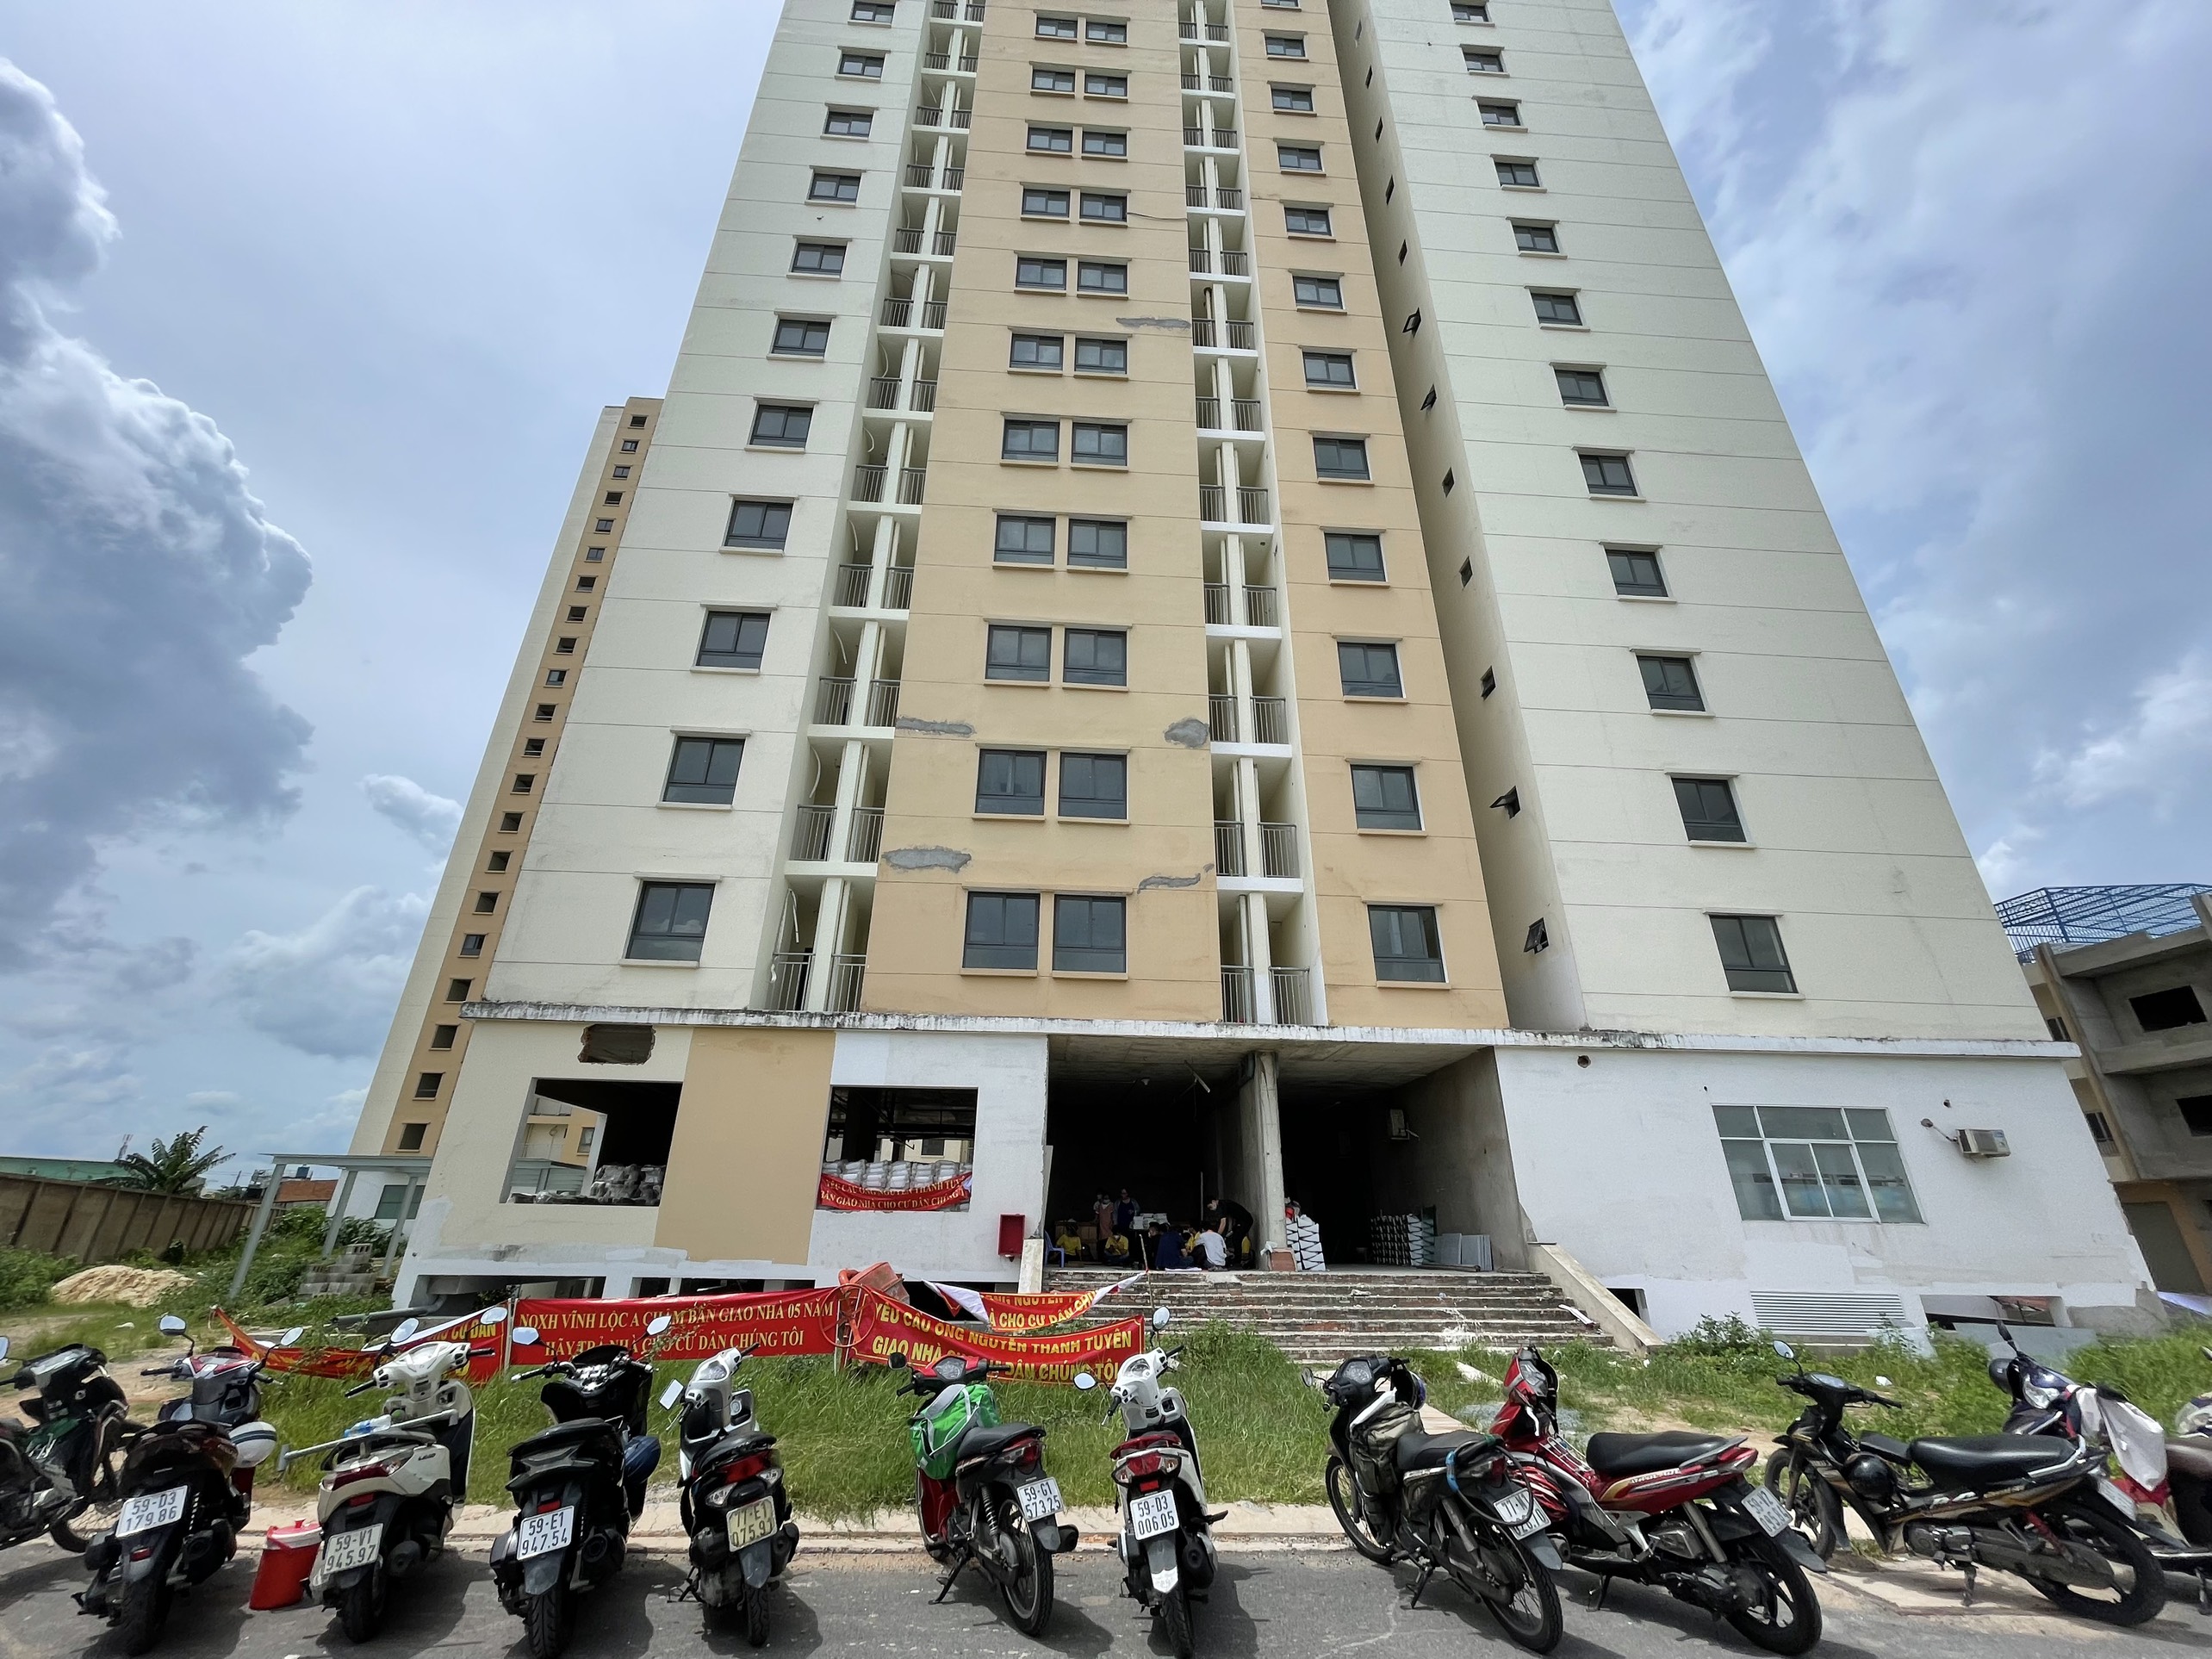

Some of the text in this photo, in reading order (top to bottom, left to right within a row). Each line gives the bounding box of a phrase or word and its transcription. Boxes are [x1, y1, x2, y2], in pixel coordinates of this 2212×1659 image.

[836, 1196, 857, 1207] GIAO
[520, 1314, 558, 1329] NOXH
[562, 1310, 596, 1329] VĨNH
[599, 1310, 628, 1332] LỘC
[630, 1313, 639, 1327] A
[718, 1306, 754, 1322] GIAO
[756, 1300, 784, 1320] NHÀ
[787, 1302, 801, 1318] 05
[804, 1298, 833, 1317] NĂM
[999, 1312, 1024, 1327] CHO
[876, 1302, 900, 1324] YÊU
[1029, 1339, 1080, 1354] THANH
[1084, 1327, 1131, 1351] TUYÊN
[544, 1338, 575, 1356] HÃY
[699, 1330, 727, 1350] DÂN
[730, 1328, 777, 1348] CHÚNG
[780, 1326, 805, 1346] TÔI
[872, 1335, 909, 1356] GIAO
[911, 1342, 942, 1363] NHÀ
[1095, 1358, 1118, 1379] TÔI
[132, 1492, 177, 1515] 59-D3
[1024, 1482, 1053, 1501] 59-G1
[1025, 1495, 1061, 1519] 573.25
[1137, 1495, 1169, 1518] 59-D3
[126, 1506, 177, 1532] 179.86
[528, 1512, 564, 1536] 59-E1
[1138, 1511, 1175, 1536] 006.05
[334, 1528, 373, 1552] 59-V1
[521, 1528, 568, 1556] 947.54
[326, 1544, 376, 1571] 945.97
